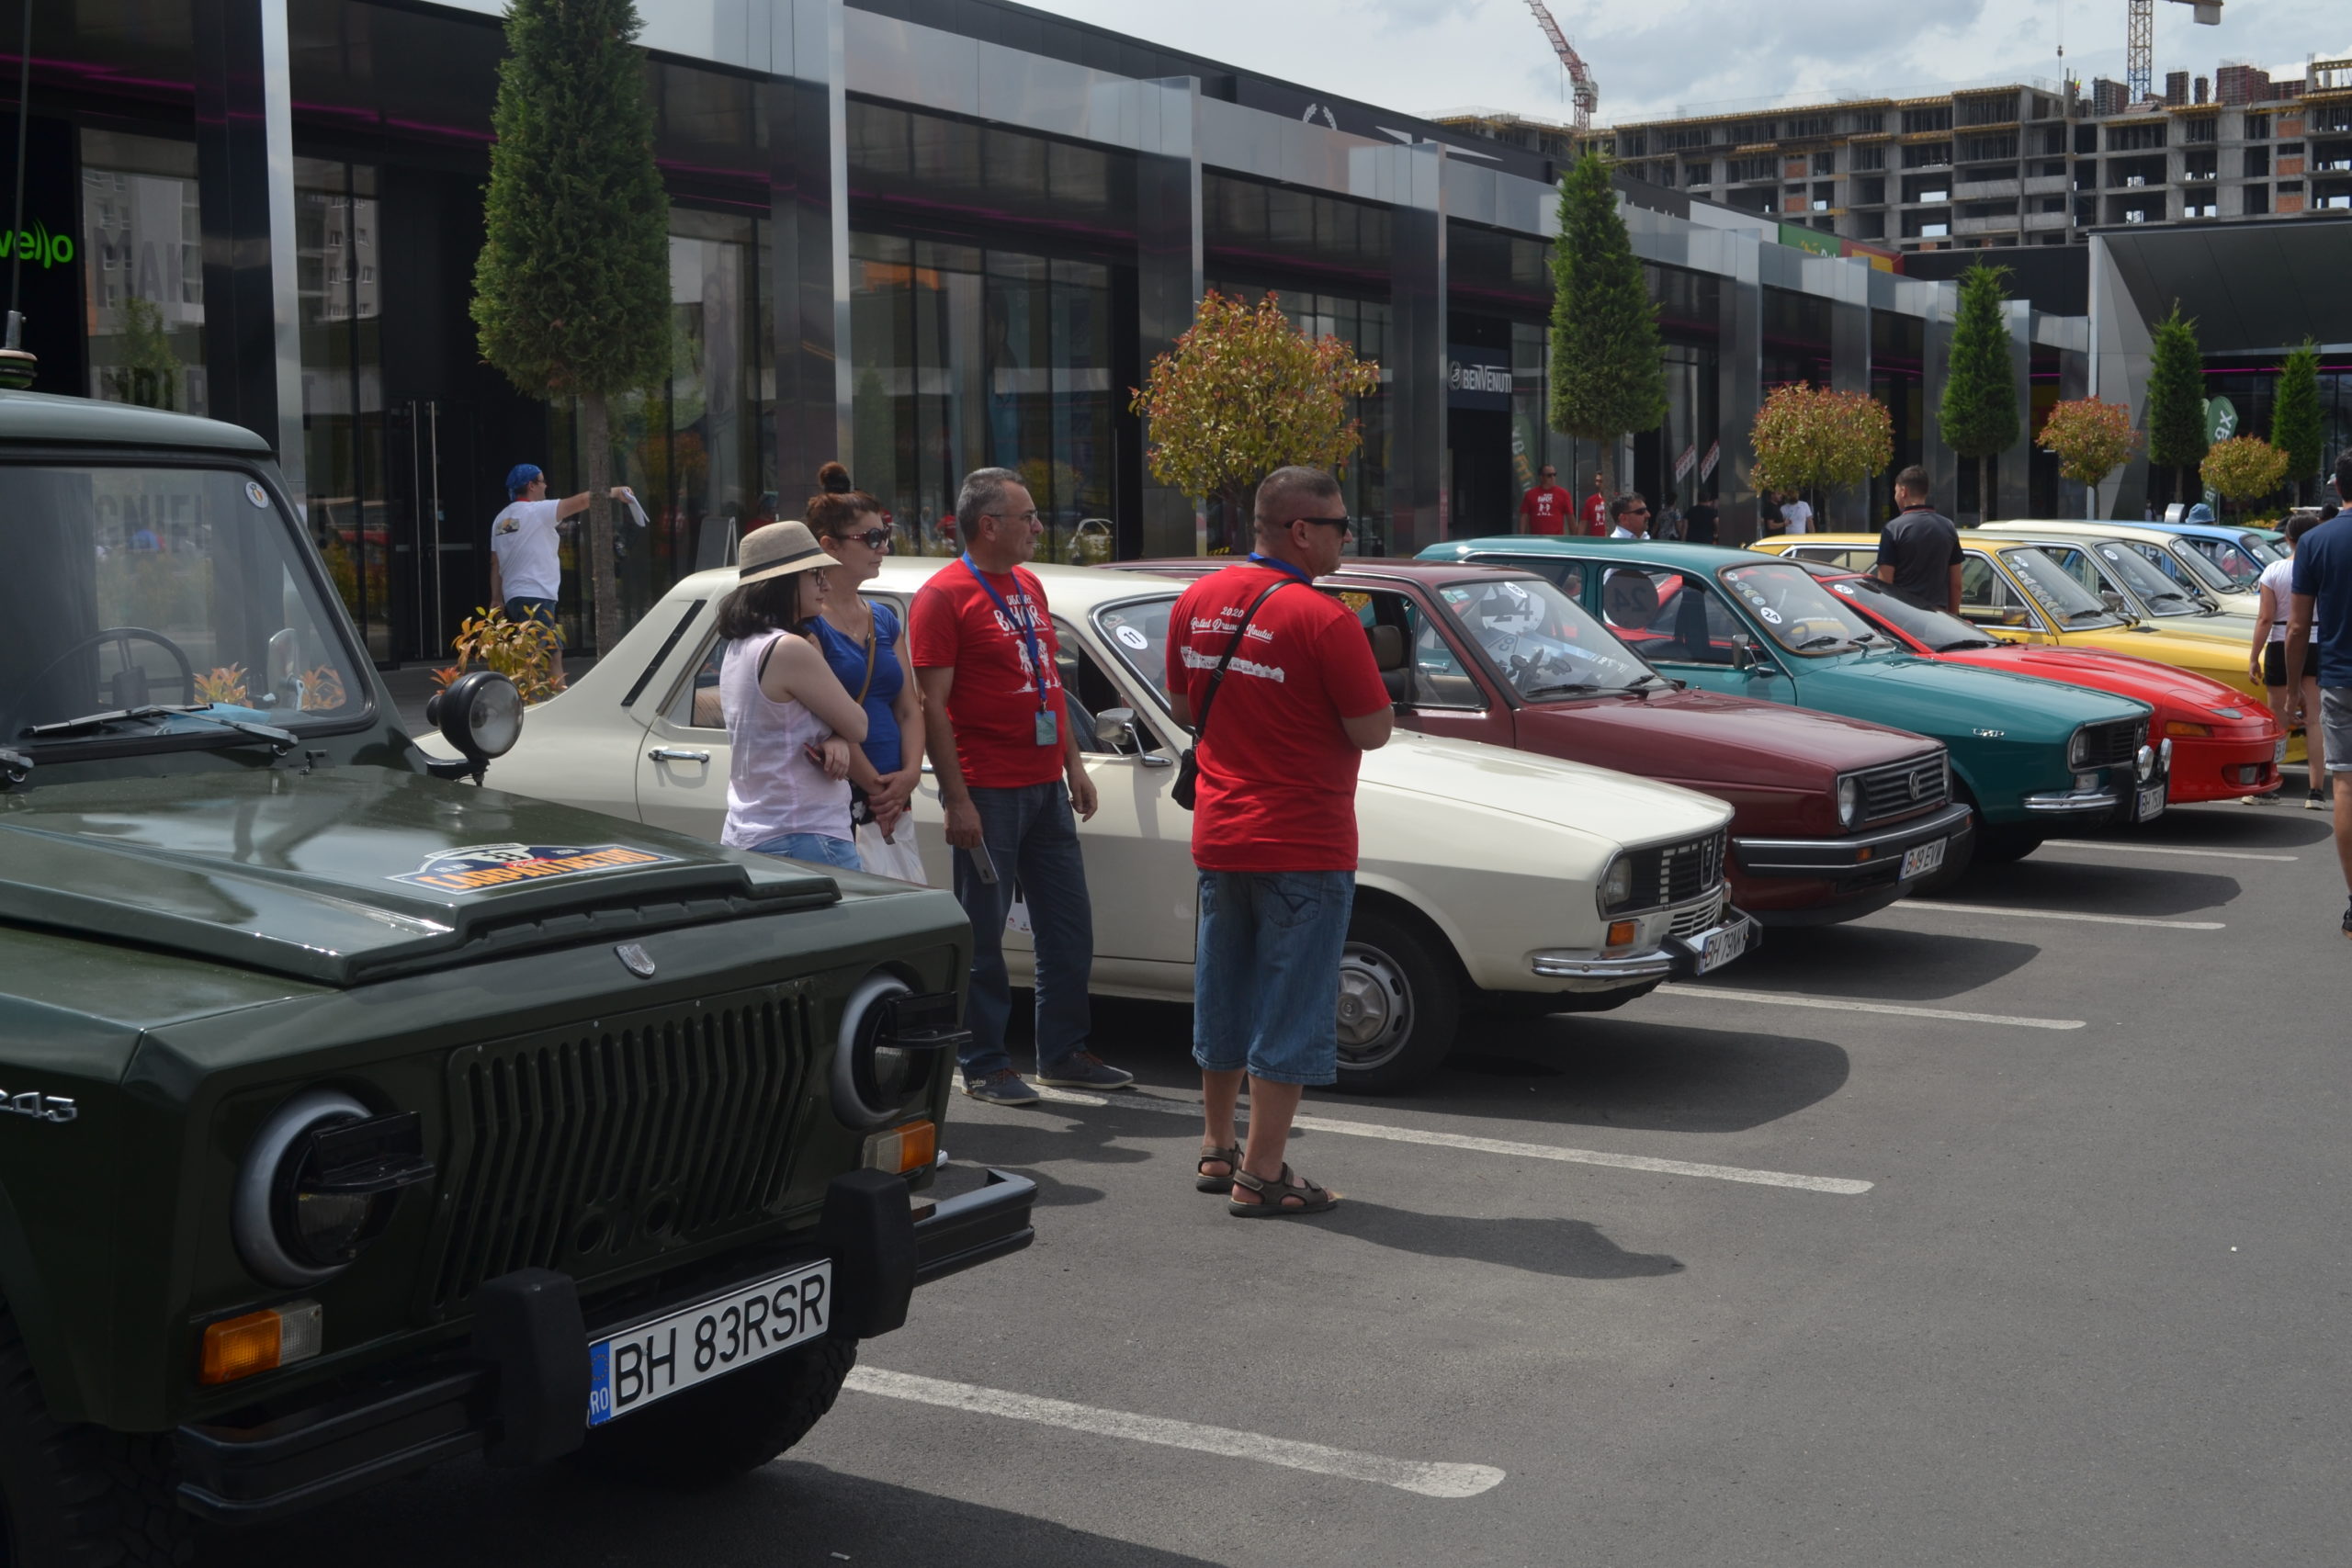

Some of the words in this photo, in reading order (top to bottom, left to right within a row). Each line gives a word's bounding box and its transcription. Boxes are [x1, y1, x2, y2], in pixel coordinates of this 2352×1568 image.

[1220, 606, 1244, 618] 2020
[1124, 631, 1141, 644] 11
[481, 852, 527, 863] 33
[553, 849, 659, 870] RETRO
[615, 1327, 676, 1408] BH
[695, 1273, 825, 1373] 83RSR
